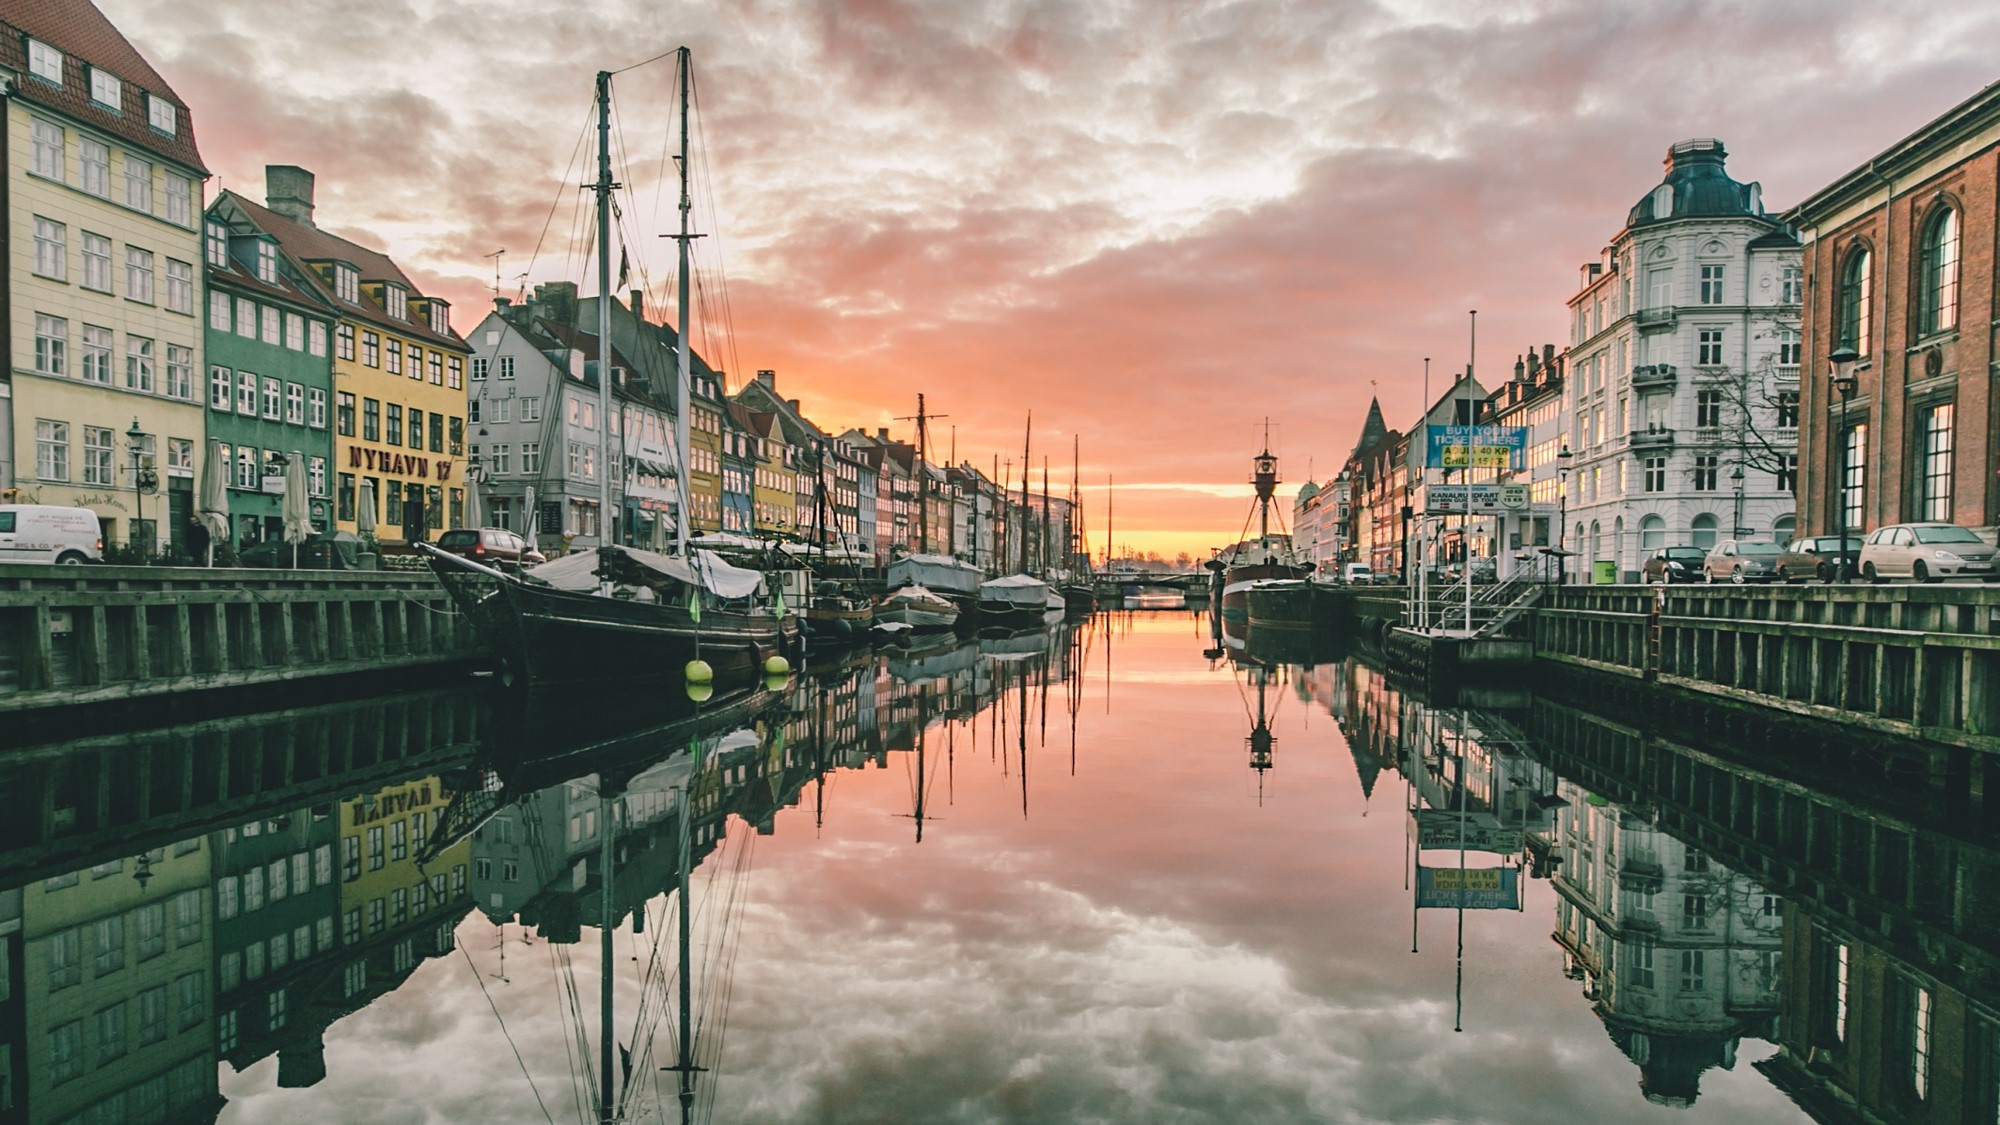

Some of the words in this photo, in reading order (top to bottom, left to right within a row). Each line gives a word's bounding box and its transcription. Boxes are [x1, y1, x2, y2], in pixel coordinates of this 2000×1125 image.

[1446, 426, 1470, 435] BUY
[1476, 426, 1510, 435] YOUR
[1487, 436, 1520, 445] HERE
[1480, 447, 1492, 455] 40
[1494, 447, 1509, 455] KR
[349, 445, 429, 478] NYHAVN
[436, 461, 452, 480] 17
[1478, 457, 1489, 465] 15
